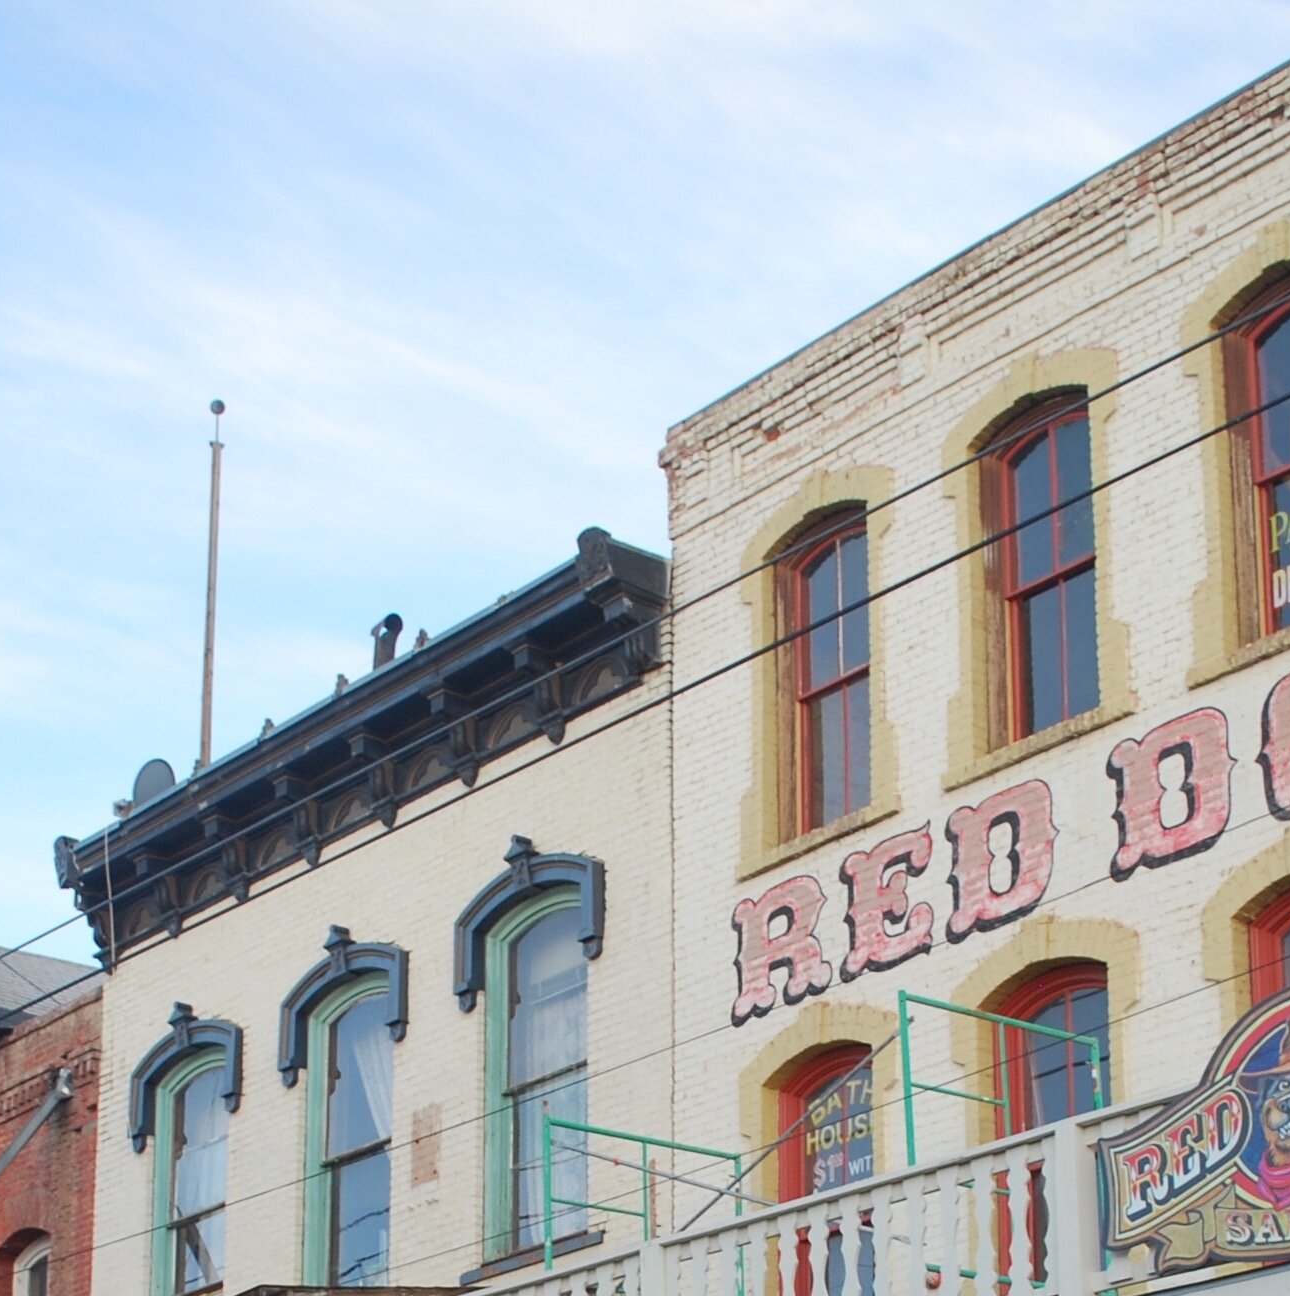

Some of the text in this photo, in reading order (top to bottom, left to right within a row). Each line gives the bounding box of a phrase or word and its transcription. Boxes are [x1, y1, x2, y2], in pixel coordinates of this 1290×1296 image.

[730, 779, 1060, 1028] RED
[806, 1113, 873, 1157] HOUS
[1120, 1088, 1245, 1222] RED
